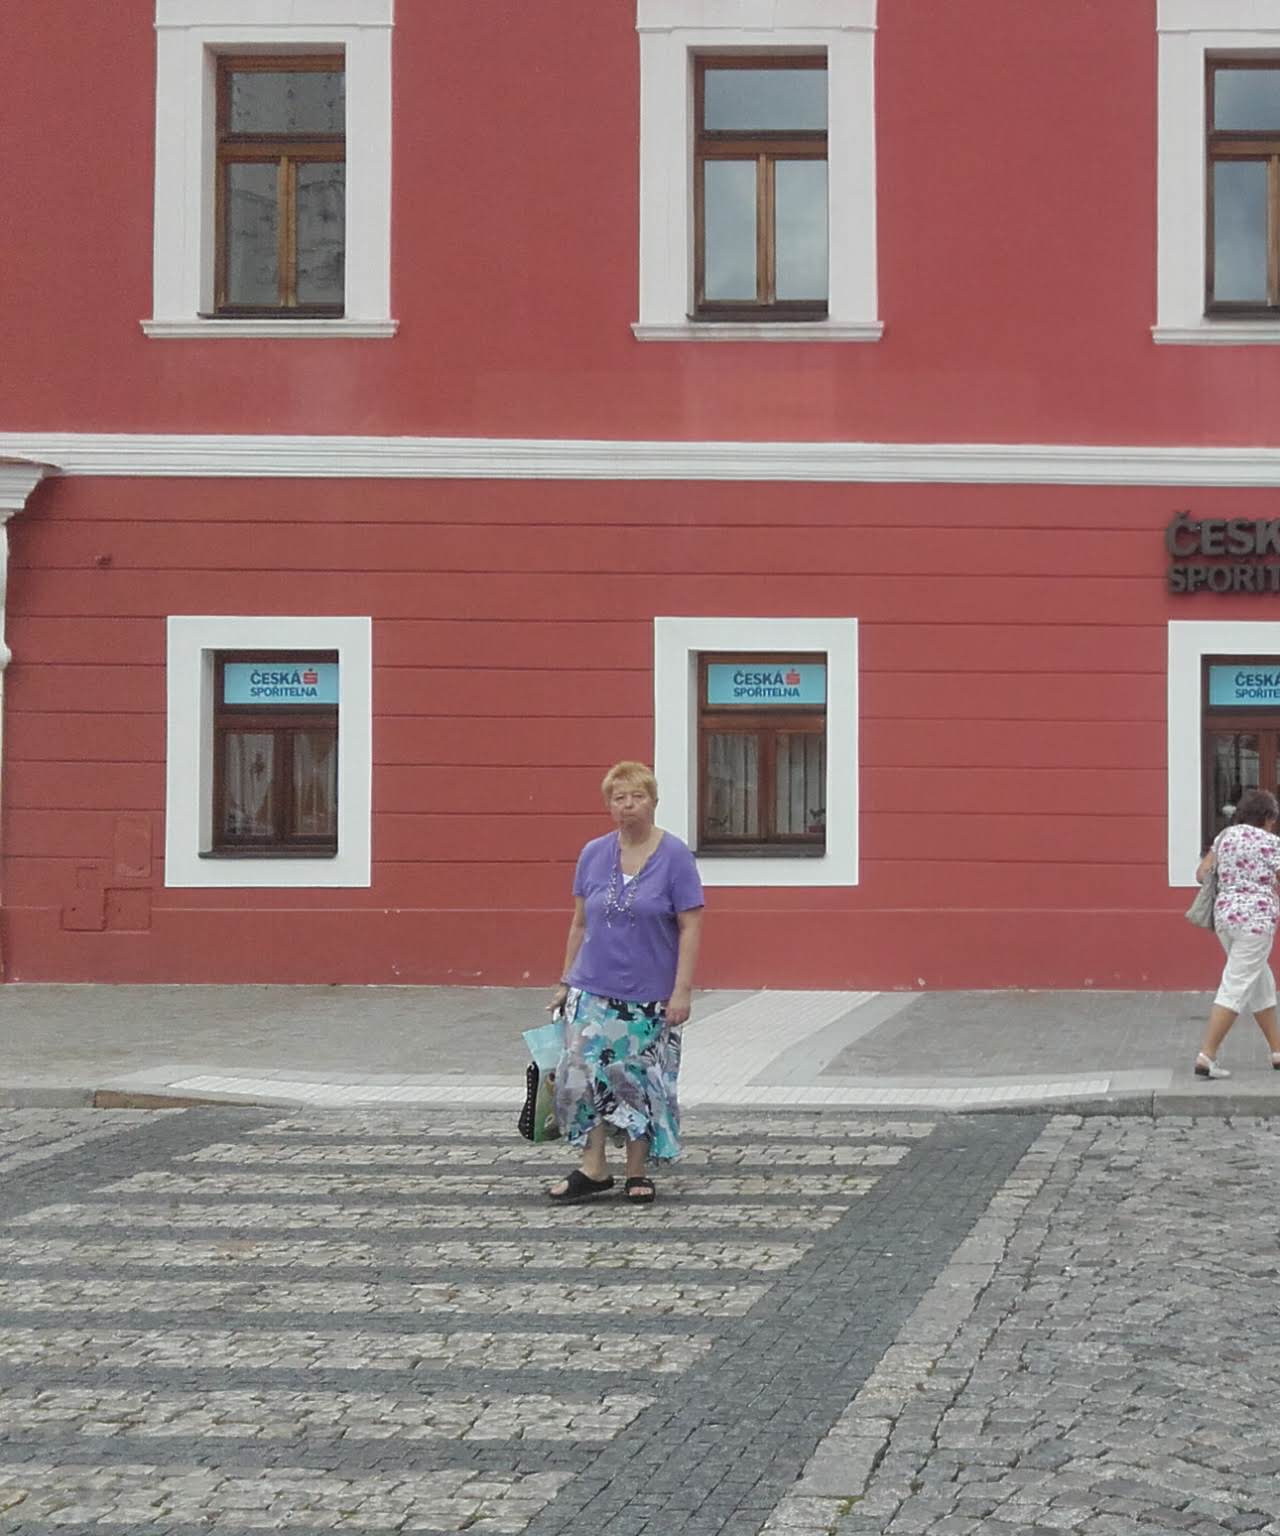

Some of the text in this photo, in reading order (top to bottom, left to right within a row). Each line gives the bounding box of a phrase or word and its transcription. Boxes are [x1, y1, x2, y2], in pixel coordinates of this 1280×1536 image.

[250, 670, 302, 685] ČESKÁ
[733, 670, 784, 686] ČESKÁ
[250, 686, 318, 697] SPOŘITELNA
[733, 686, 800, 698] SPOŘITELNA
